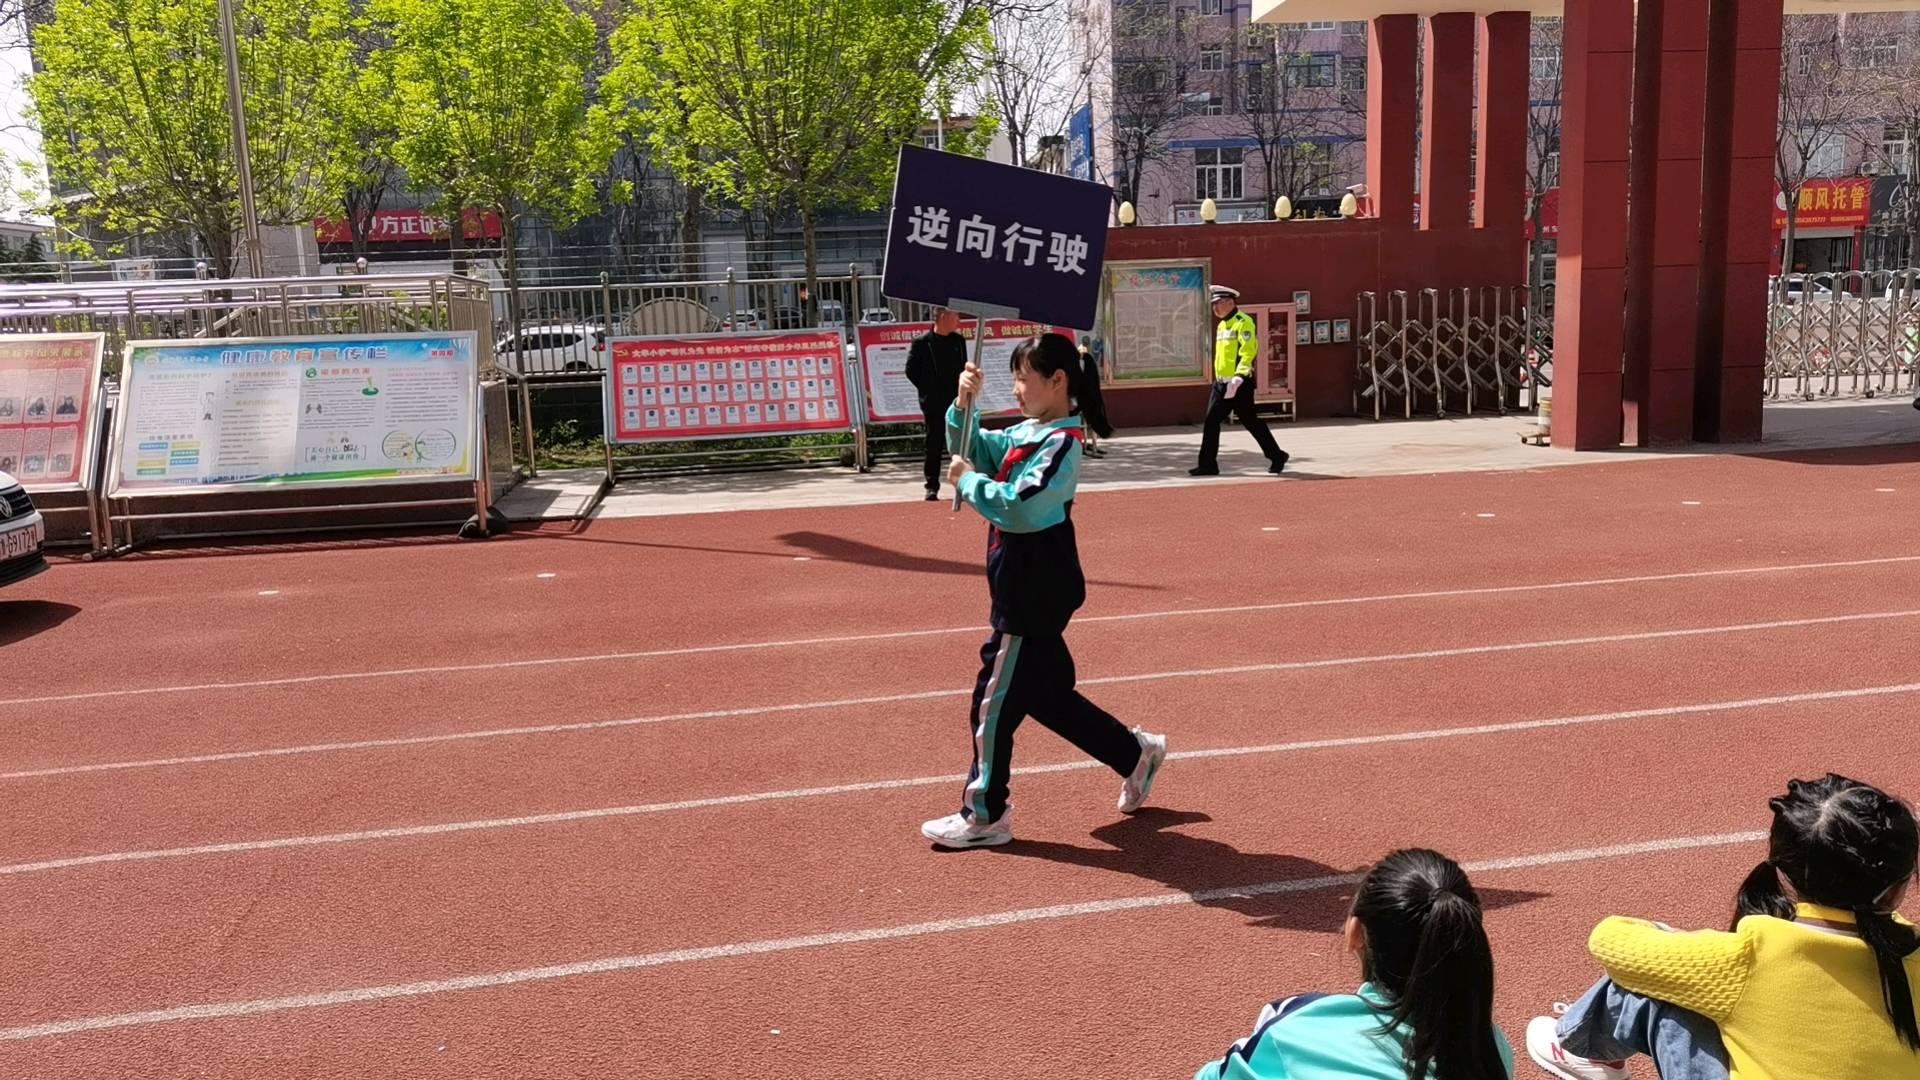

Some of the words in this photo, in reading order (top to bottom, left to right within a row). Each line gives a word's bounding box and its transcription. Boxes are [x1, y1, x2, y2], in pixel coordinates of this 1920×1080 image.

[1798, 185, 1865, 211] 顺风托管
[906, 205, 1089, 276] 逆向行驶
[222, 346, 387, 364] 健康教育宣传栏
